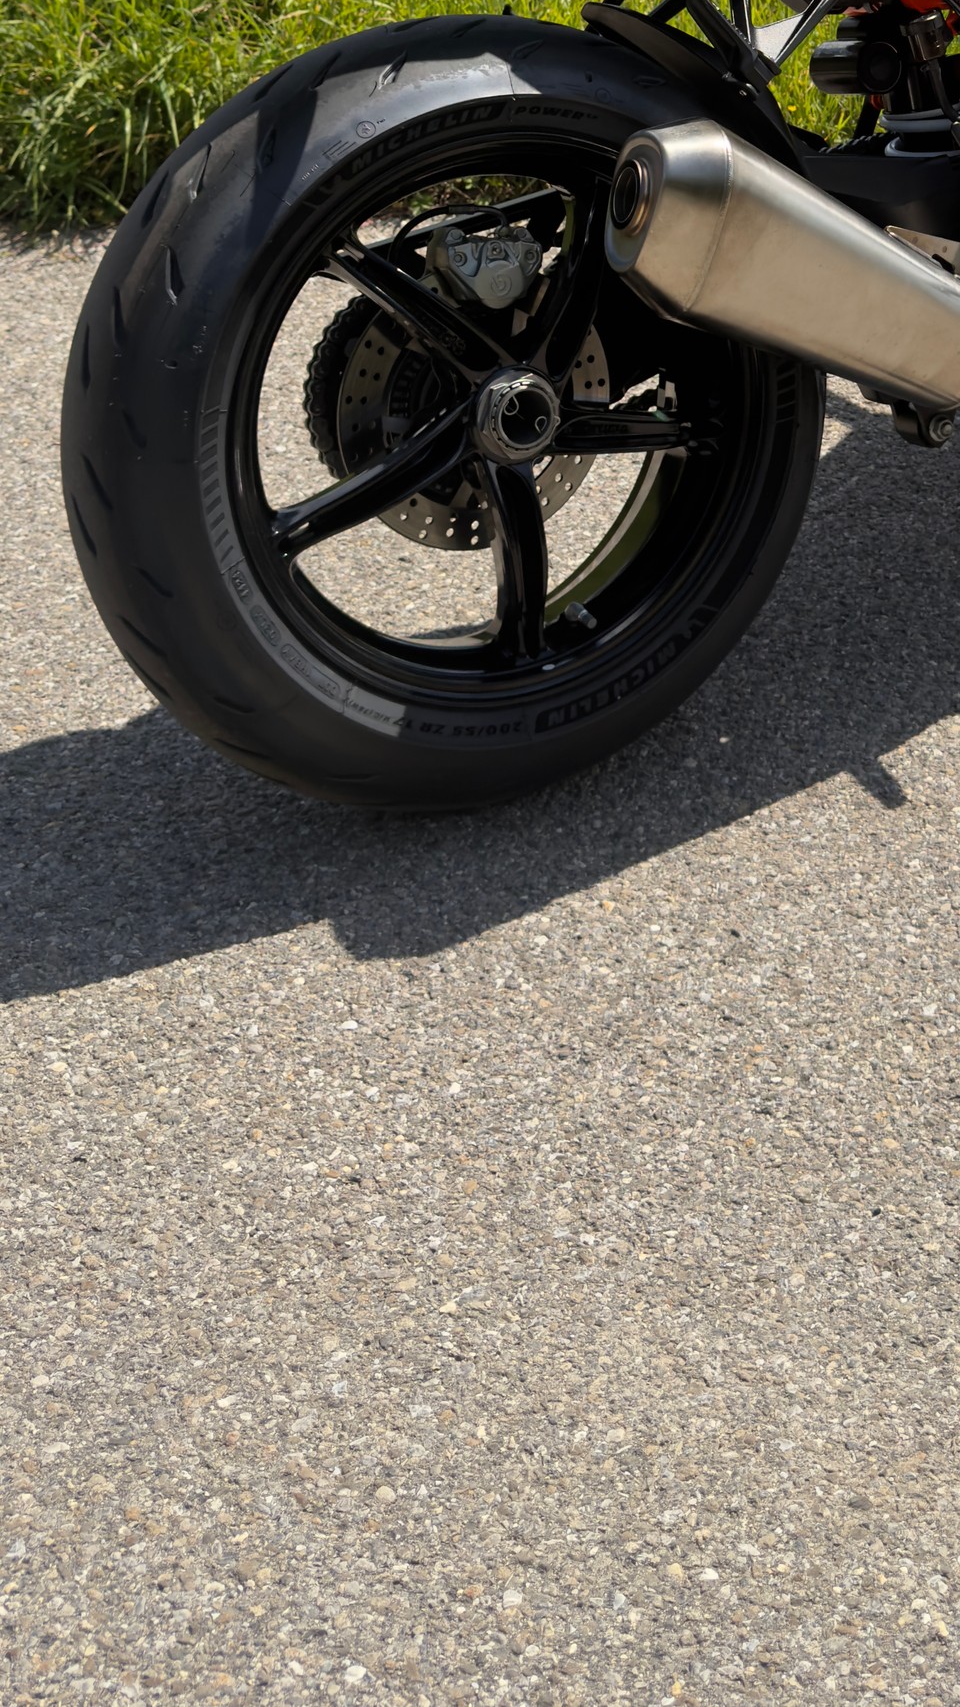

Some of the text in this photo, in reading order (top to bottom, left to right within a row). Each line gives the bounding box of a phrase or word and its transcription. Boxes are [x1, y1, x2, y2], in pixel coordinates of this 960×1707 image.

[351, 103, 584, 175] MICHELIN POWER
[548, 641, 676, 727] MICHELIN
[419, 721, 446, 735] ZR
[451, 721, 523, 737] 200/55
